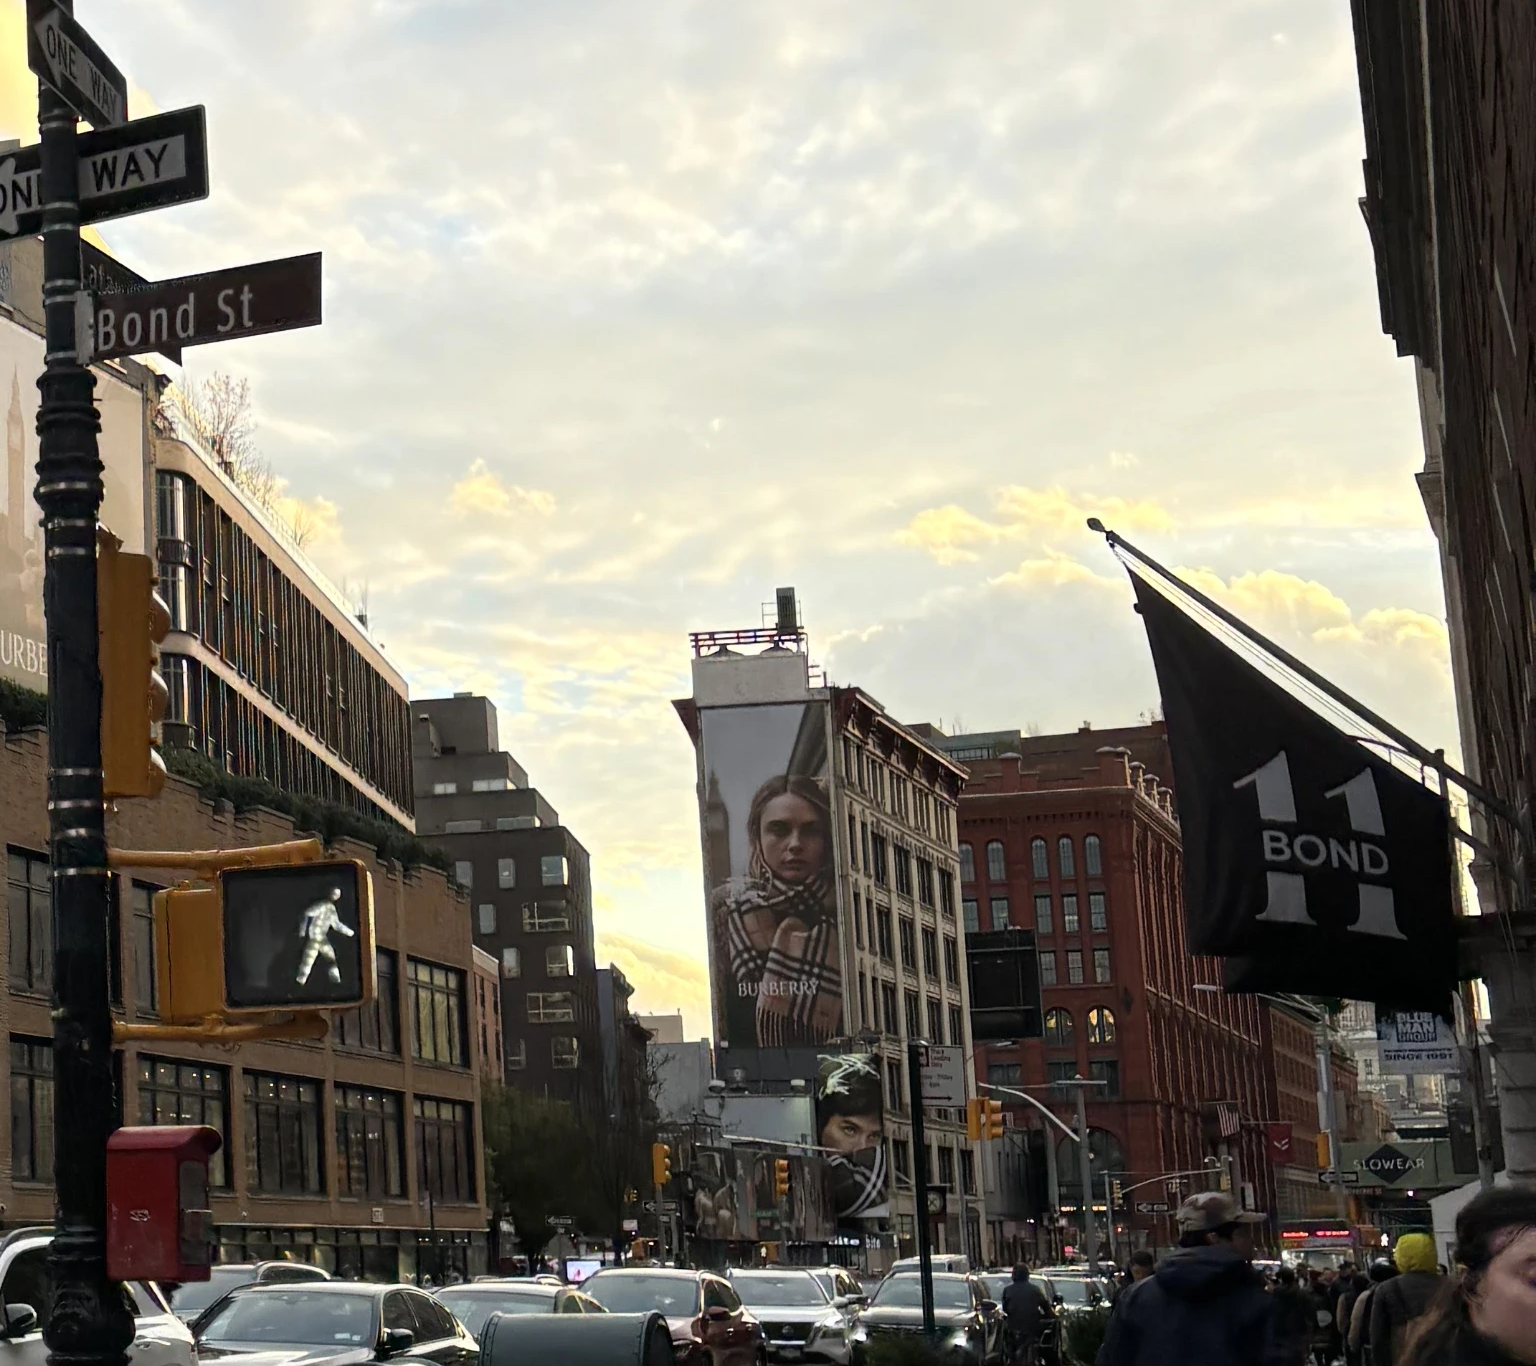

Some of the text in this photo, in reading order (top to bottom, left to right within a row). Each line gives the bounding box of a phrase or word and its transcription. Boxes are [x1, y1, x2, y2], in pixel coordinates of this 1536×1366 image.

[46, 23, 119, 122] ONE WAY
[91, 143, 169, 193] WAY
[97, 284, 254, 352] Bond St
[1262, 829, 1390, 875] BOND
[738, 978, 820, 997] BURBERRY
[1397, 1022, 1436, 1033] MAN
[1353, 1158, 1425, 1171] SLOWEAR
